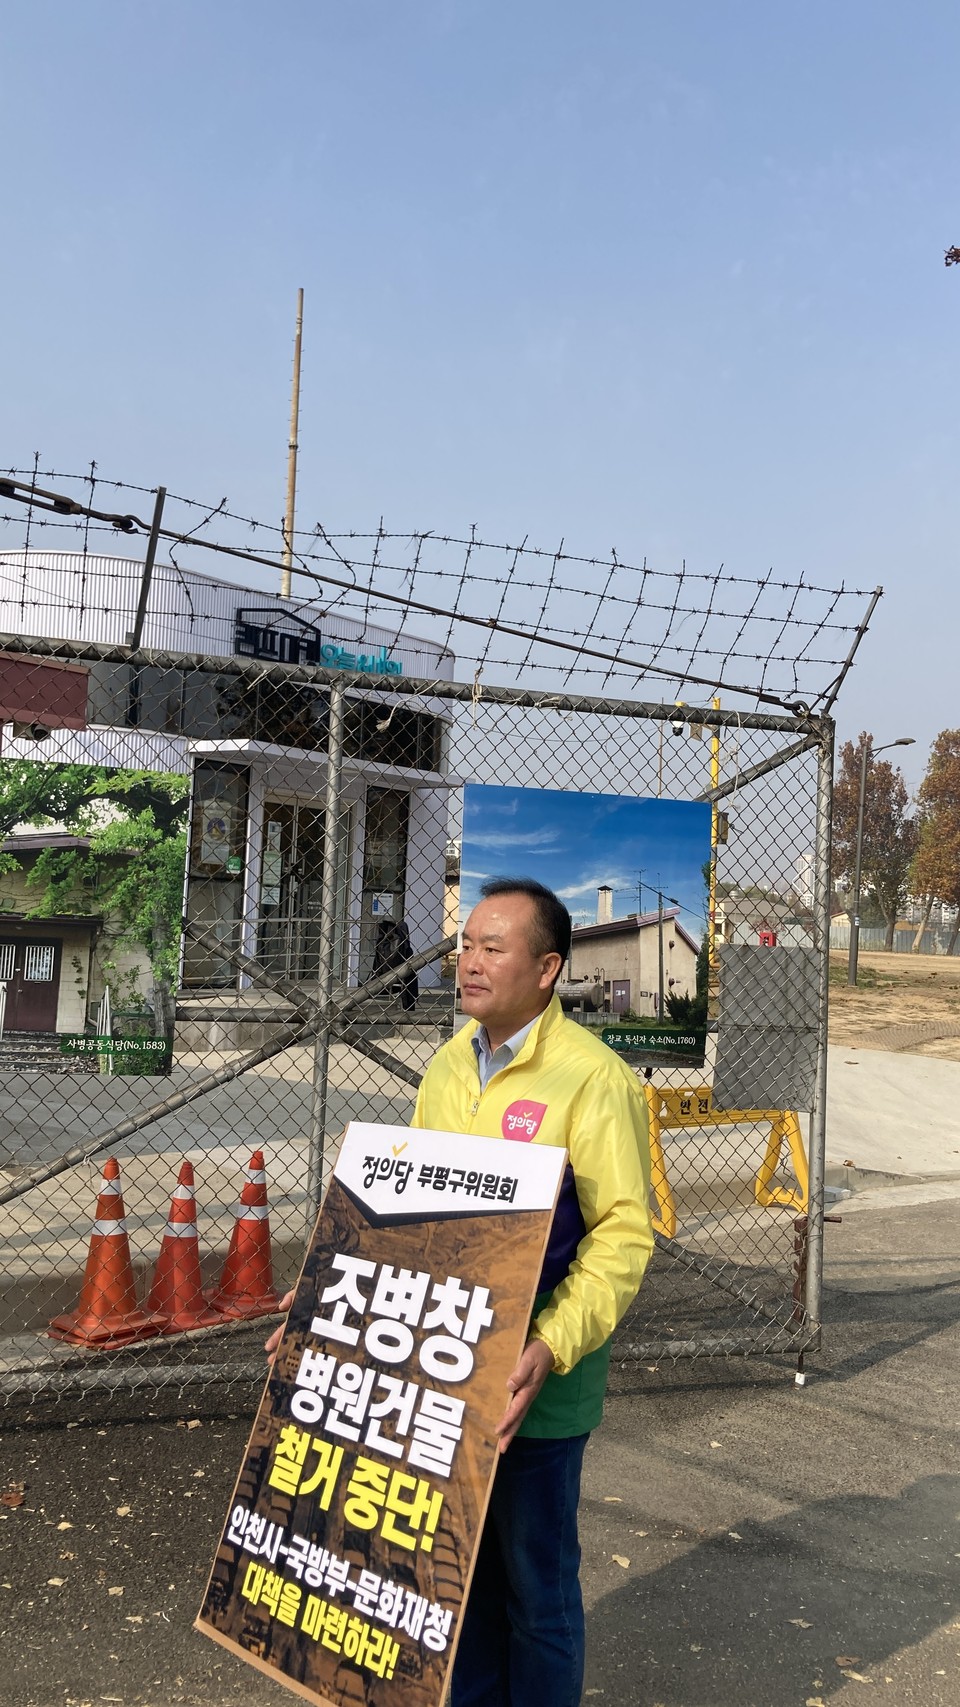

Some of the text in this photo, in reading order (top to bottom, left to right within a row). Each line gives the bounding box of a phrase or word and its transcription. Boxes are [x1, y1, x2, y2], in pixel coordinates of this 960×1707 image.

[66, 1038, 167, 1052] 사병공동식당(No.1583)
[607, 1034, 697, 1046] 장교 독신자 숙소(No.1760)
[507, 1114, 537, 1135] 정의당
[362, 1155, 519, 1203] 정의당 부평구위원회
[310, 1252, 494, 1383] 조병창
[290, 1348, 466, 1478] 병원건물
[268, 1424, 444, 1553] 철거 중단!
[241, 1561, 400, 1680] 대책을 마련하라!
